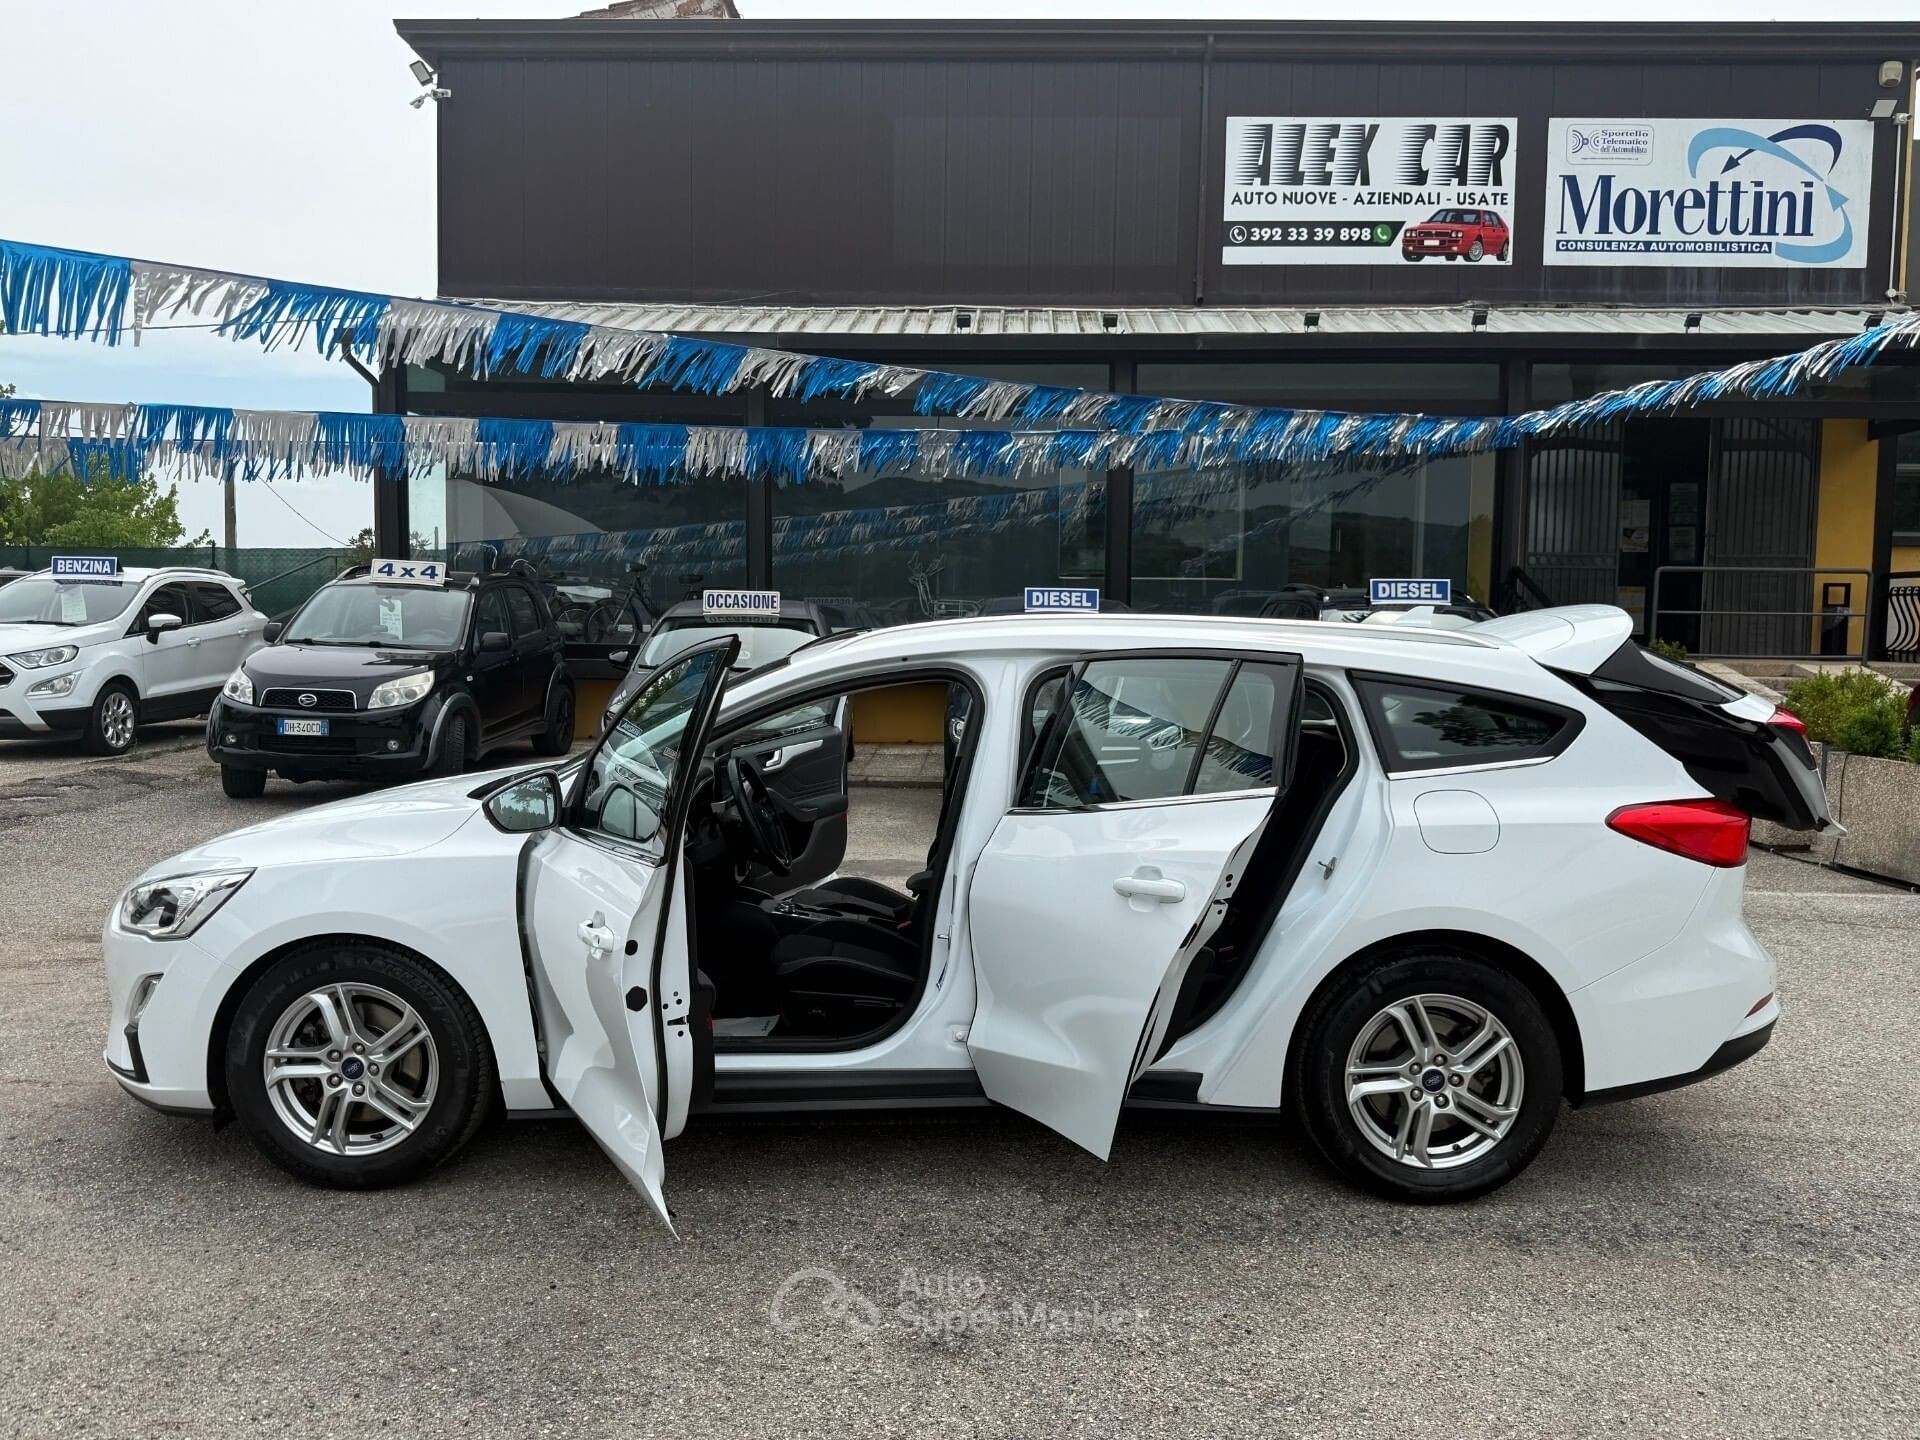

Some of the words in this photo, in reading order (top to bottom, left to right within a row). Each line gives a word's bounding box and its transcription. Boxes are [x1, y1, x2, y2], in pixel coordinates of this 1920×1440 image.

[1601, 129, 1649, 137] Sportello
[1601, 137, 1648, 145] Telematico
[1233, 123, 1380, 186] ALEX
[1394, 124, 1510, 187] CAR
[1231, 191, 1278, 205] AUTO
[1282, 191, 1337, 205] NUOVE
[1353, 191, 1441, 206] AZIENDALI
[1456, 192, 1509, 206] USATE
[1556, 174, 1814, 237] Morettini
[1250, 227, 1282, 241] 392
[1287, 227, 1309, 241] 33
[1313, 227, 1335, 241] 39
[1339, 227, 1371, 241] 898
[1558, 240, 1645, 252] CONSULENZA
[1649, 241, 1770, 253] AUTOMOBILISTICA
[57, 559, 111, 574] BENZINA
[1377, 582, 1443, 599] DIESEL
[707, 593, 777, 609] OCCASIONE
[1032, 591, 1092, 607] DIESEL
